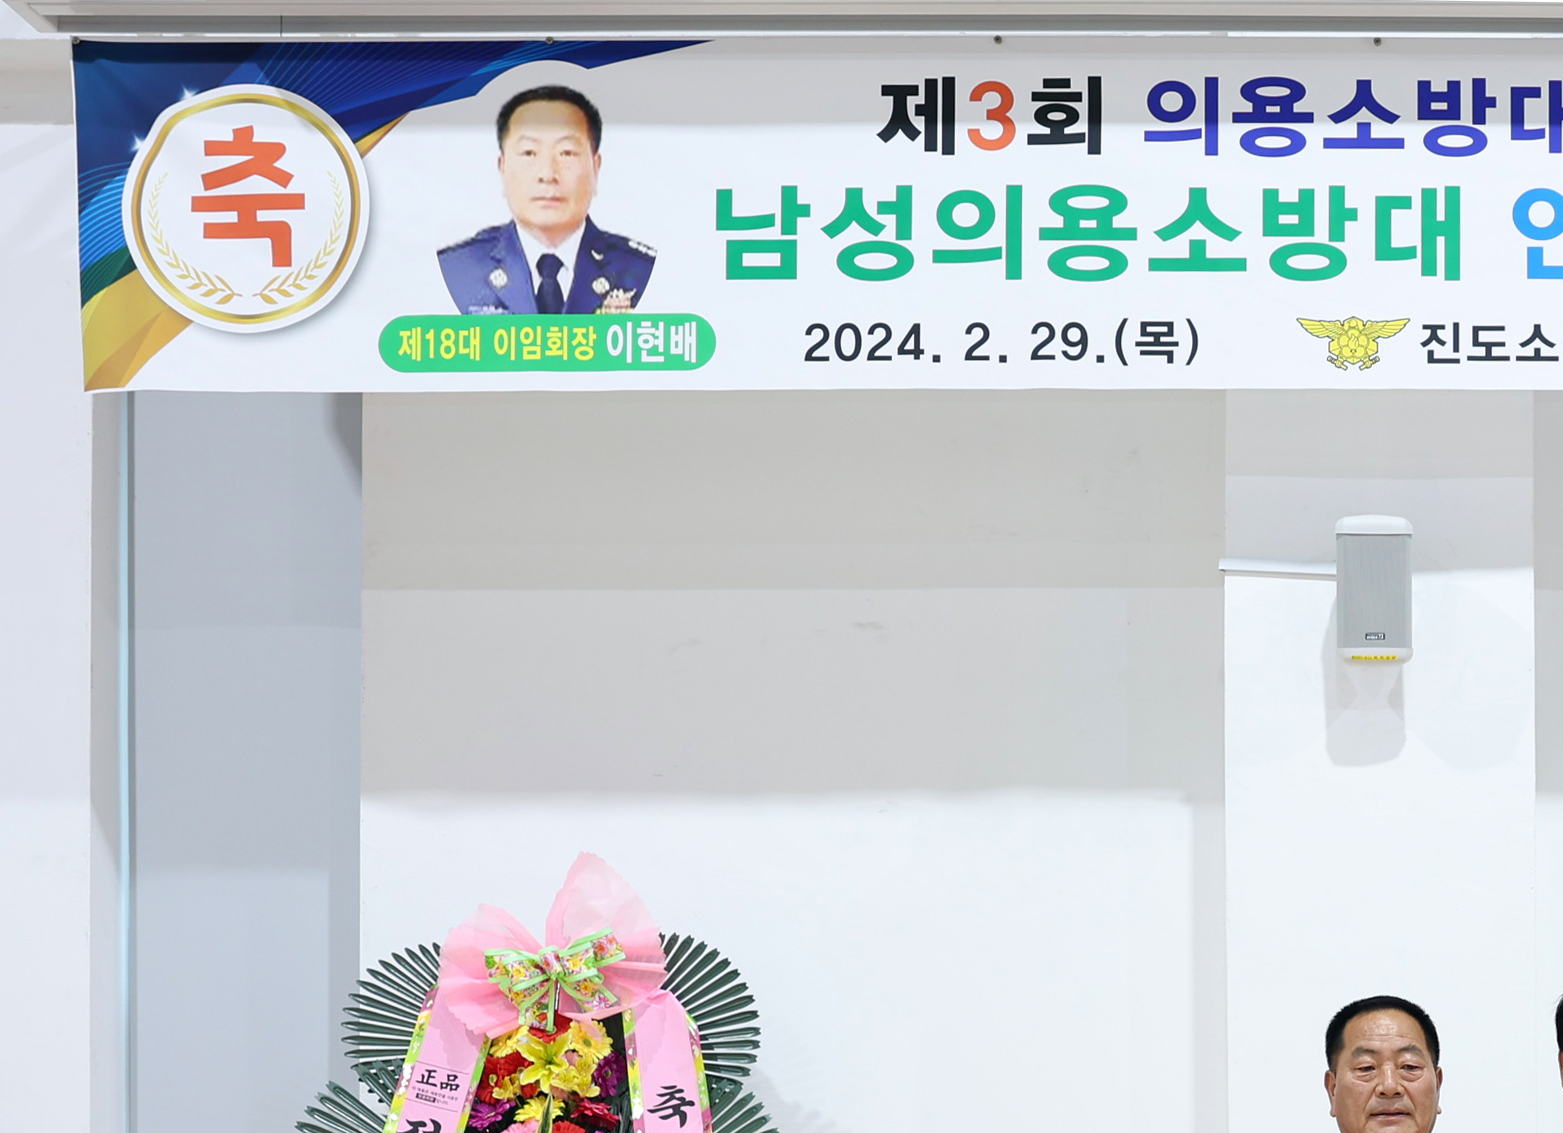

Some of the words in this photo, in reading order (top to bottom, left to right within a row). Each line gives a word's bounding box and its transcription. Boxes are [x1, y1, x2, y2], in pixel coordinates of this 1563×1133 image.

[876, 75, 1102, 156] 제3회
[190, 124, 306, 269] 축
[715, 184, 1461, 282] 남성의용소방대
[397, 326, 482, 362] 제18대
[493, 326, 598, 362] 이임회장
[605, 320, 699, 364] 이현배
[804, 321, 941, 364] 2024.
[963, 321, 1006, 364] 2.
[1030, 317, 1200, 367] 29.(목)
[415, 1068, 460, 1092] 正品
[647, 1085, 696, 1129] 축
